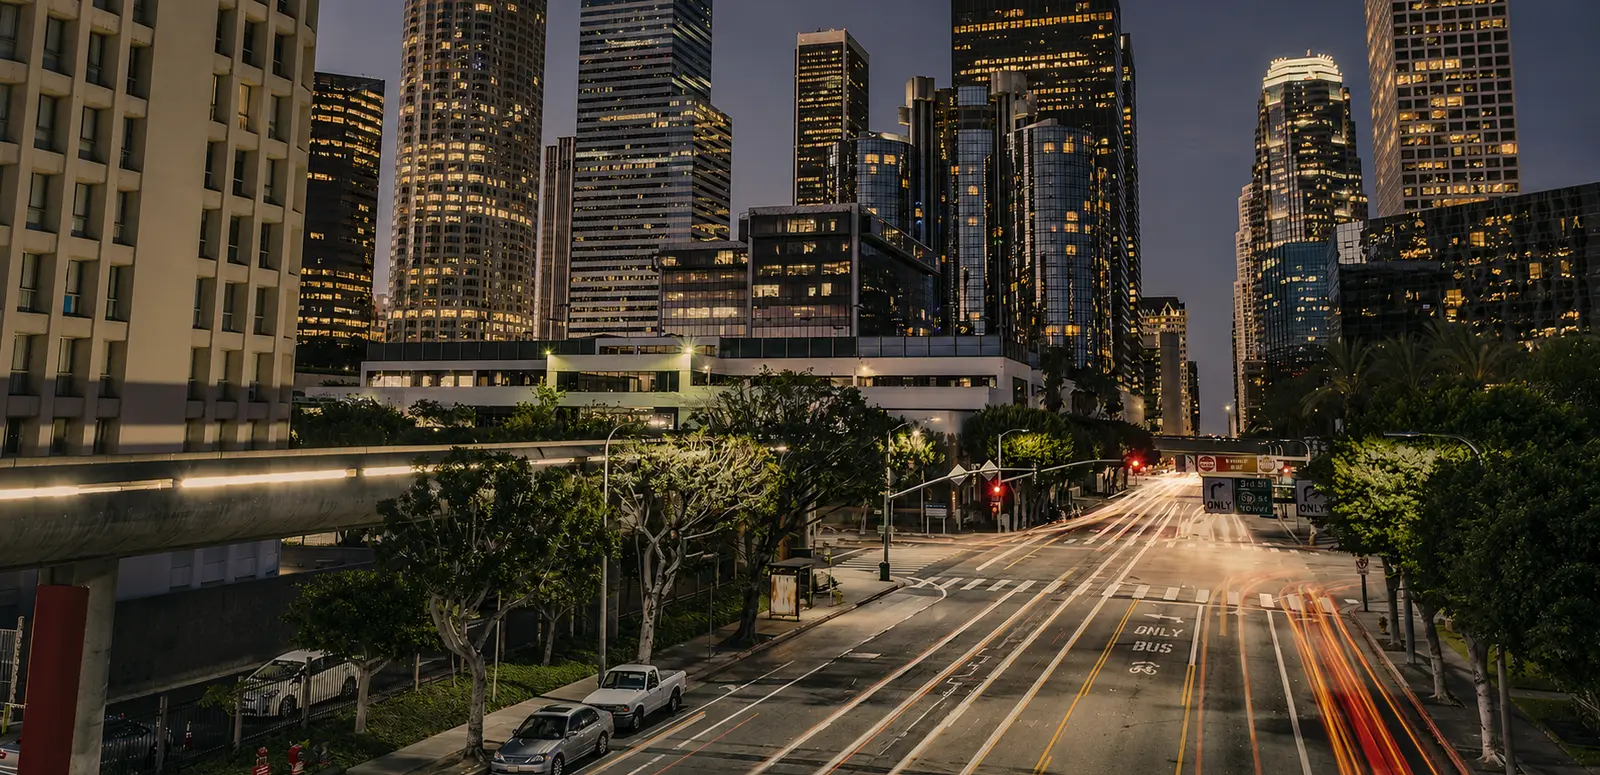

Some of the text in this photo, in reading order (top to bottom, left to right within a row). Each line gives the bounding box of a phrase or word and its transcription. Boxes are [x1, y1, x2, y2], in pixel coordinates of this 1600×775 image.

[1207, 501, 1231, 510] ONLY
[1300, 503, 1324, 512] ONLY
[1133, 625, 1183, 637] ONLY
[1132, 640, 1173, 653] BUS
